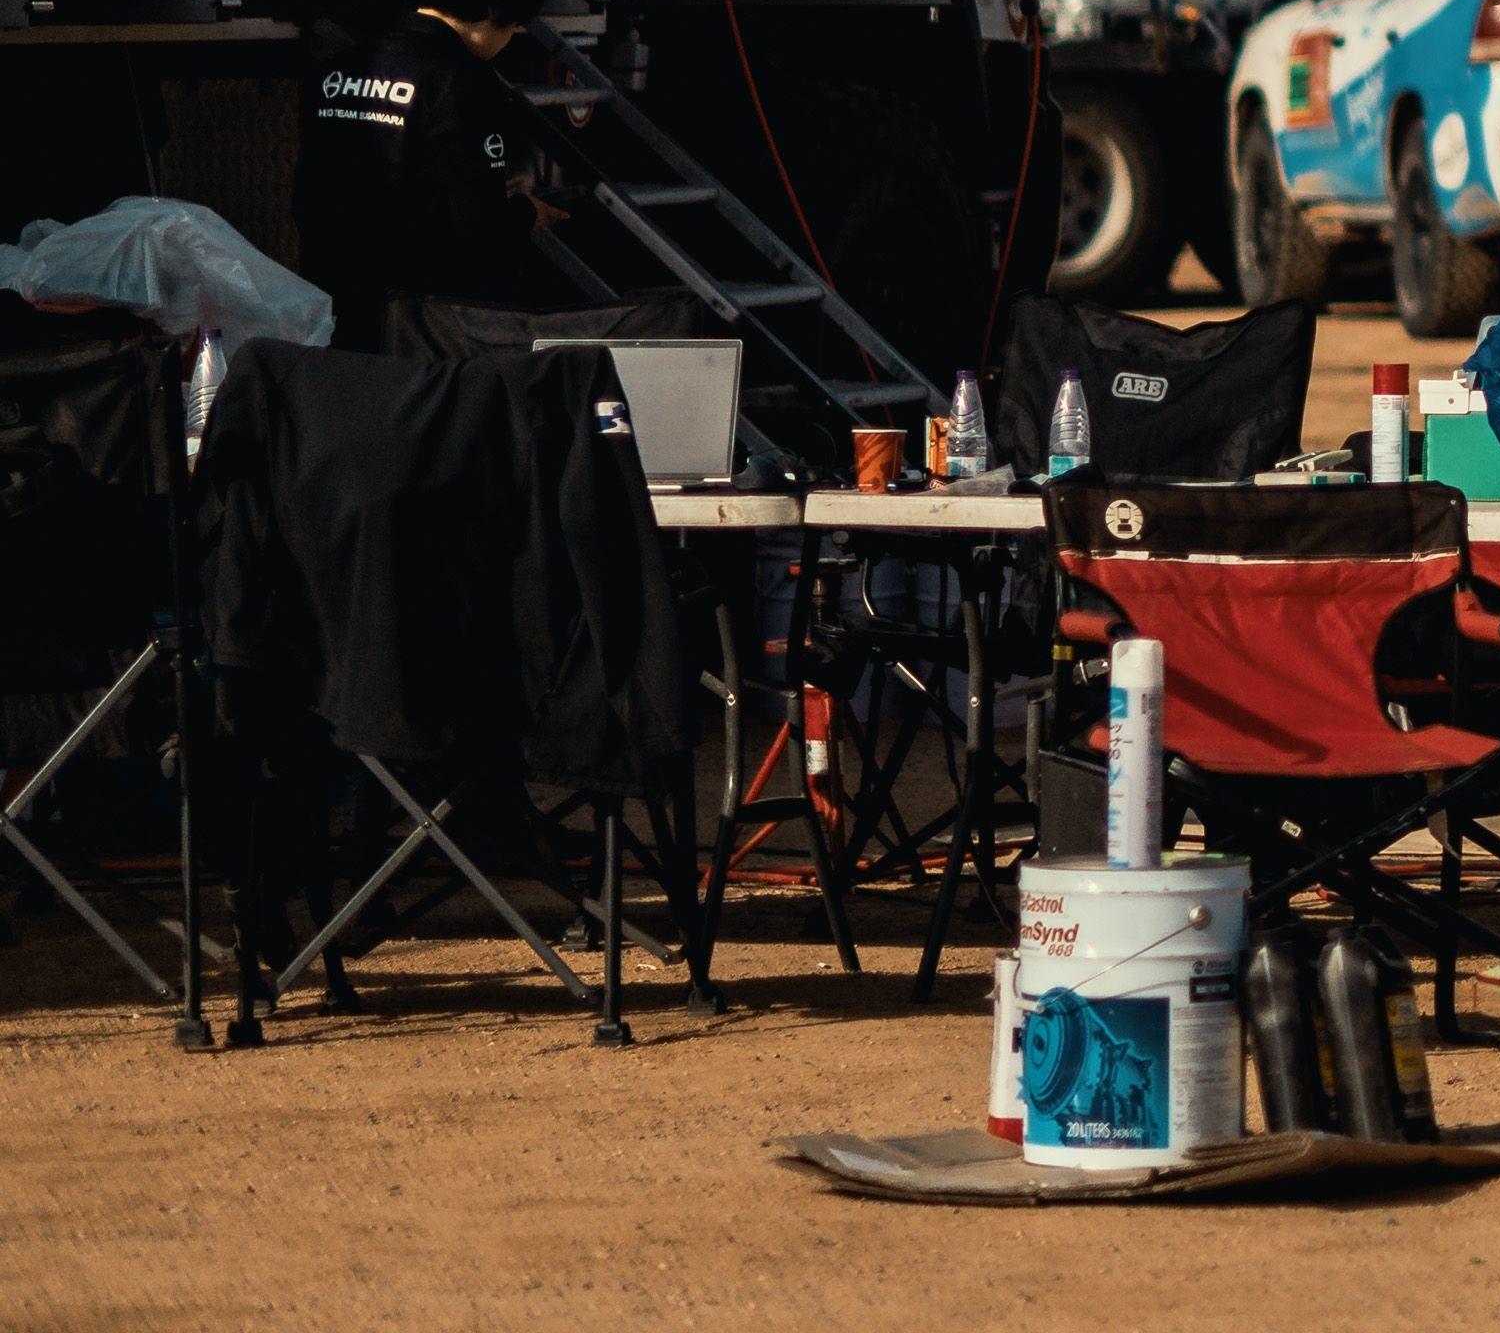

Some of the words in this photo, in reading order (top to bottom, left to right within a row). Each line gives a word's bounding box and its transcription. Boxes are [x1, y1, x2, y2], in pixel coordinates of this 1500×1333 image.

[341, 77, 416, 105] HINO
[1117, 376, 1162, 397] ARB
[1047, 943, 1074, 958] 668
